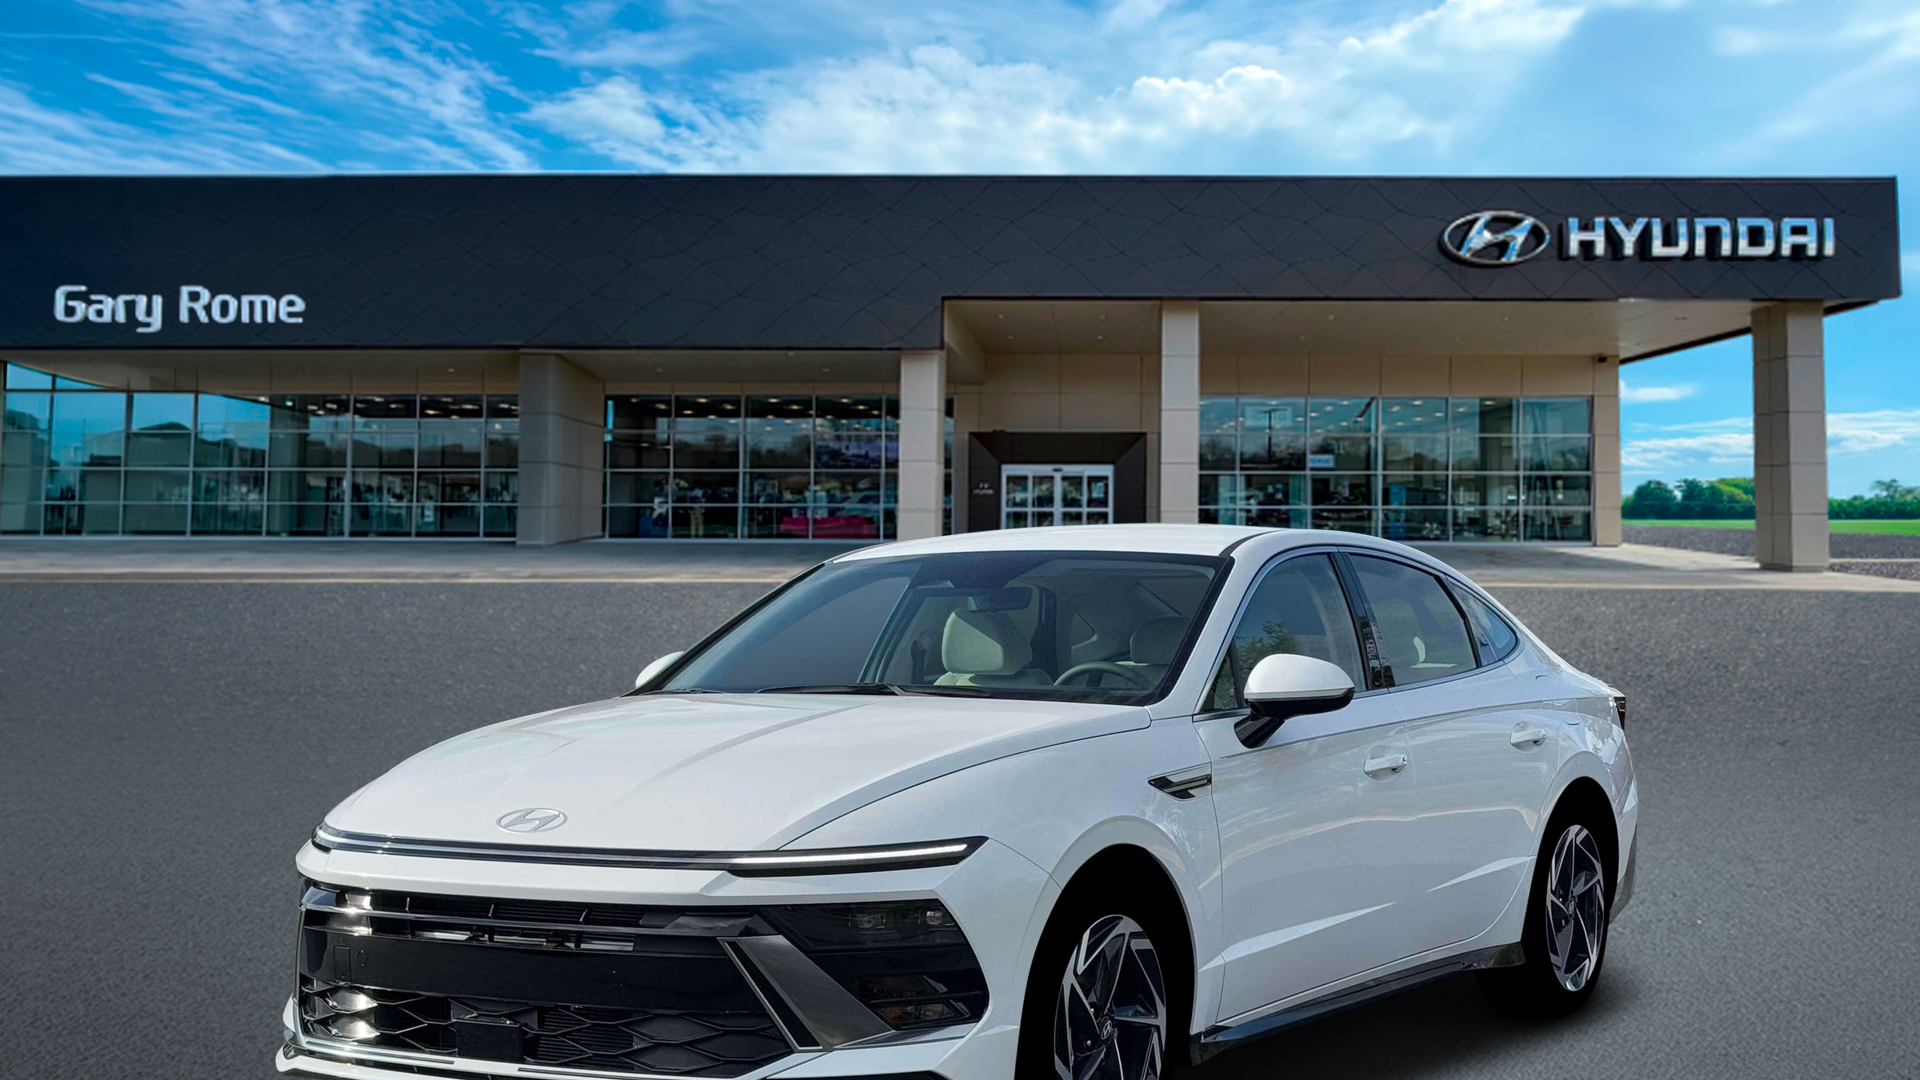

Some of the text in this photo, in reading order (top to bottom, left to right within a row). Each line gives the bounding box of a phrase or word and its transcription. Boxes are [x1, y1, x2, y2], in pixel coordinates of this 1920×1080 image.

[1567, 217, 1836, 257] HYUNDAI
[53, 284, 306, 334] Gary Rome
